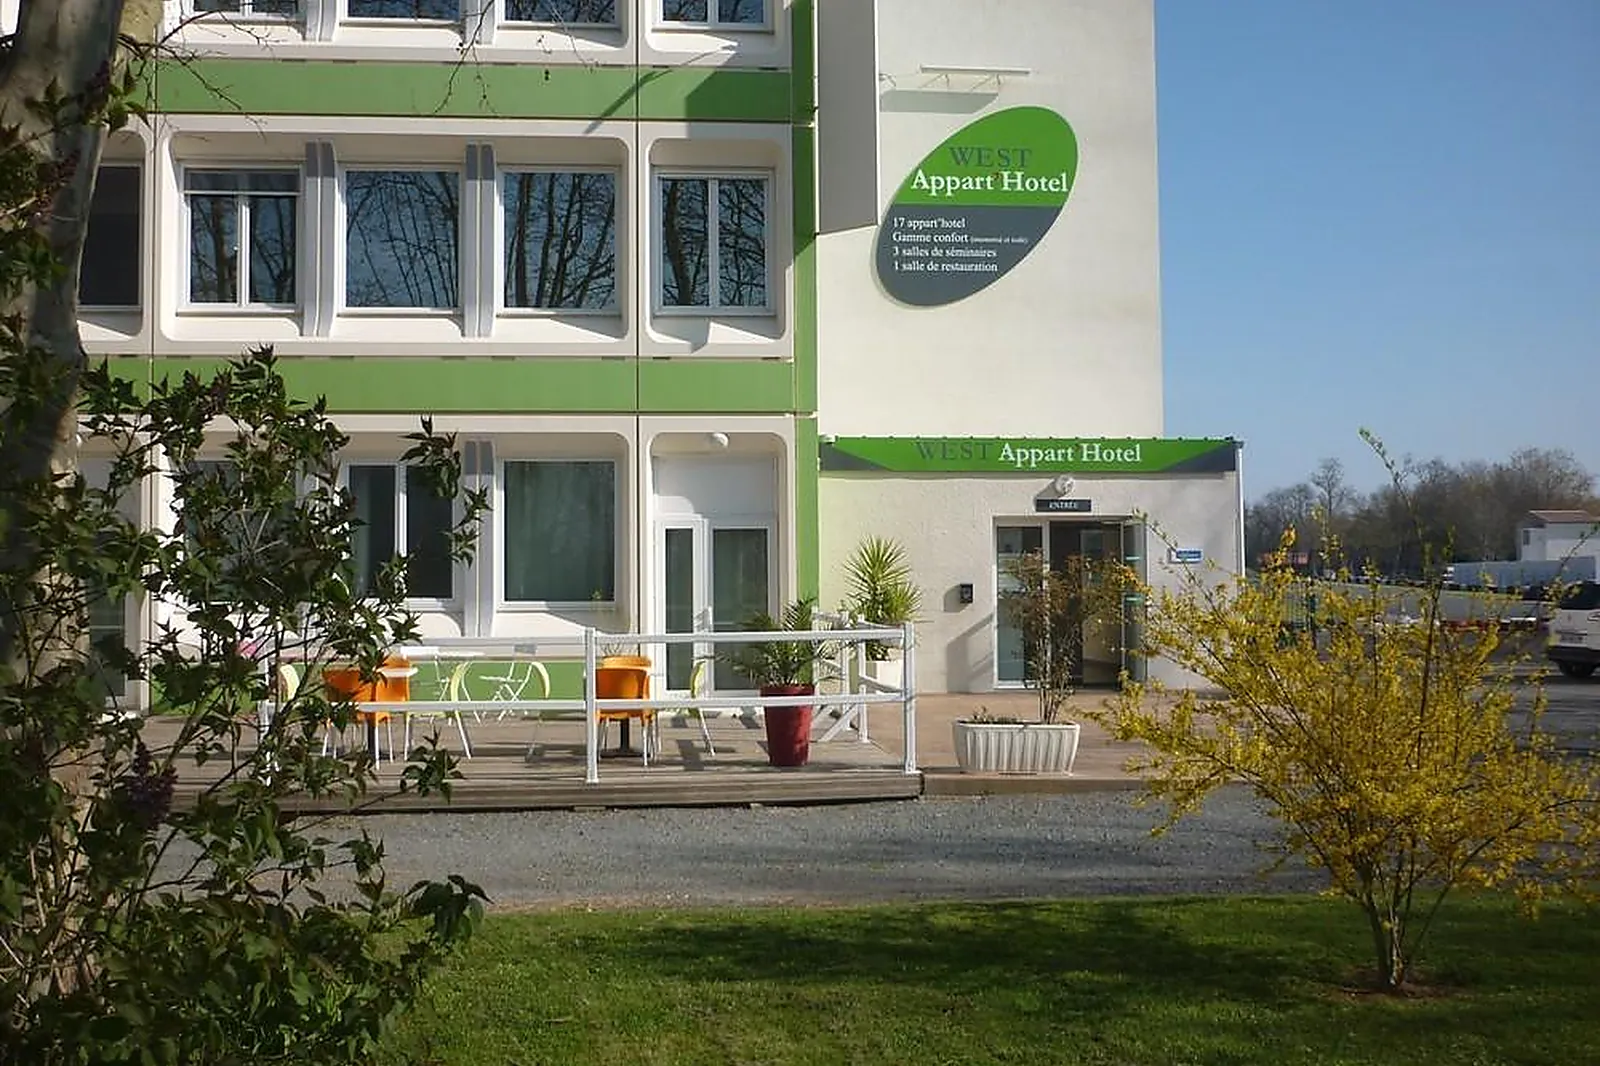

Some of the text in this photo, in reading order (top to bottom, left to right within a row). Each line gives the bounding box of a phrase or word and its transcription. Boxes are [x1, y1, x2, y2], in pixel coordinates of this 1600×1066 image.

[949, 146, 1033, 168] WEST
[893, 217, 905, 228] 17
[892, 231, 932, 243] Gamme
[933, 231, 969, 243] confort
[892, 246, 899, 256] 3
[902, 246, 929, 257] salles
[931, 246, 944, 257] de
[902, 261, 925, 271] salle
[927, 261, 940, 272] de
[941, 261, 999, 273] restauration
[914, 440, 993, 461] WEST
